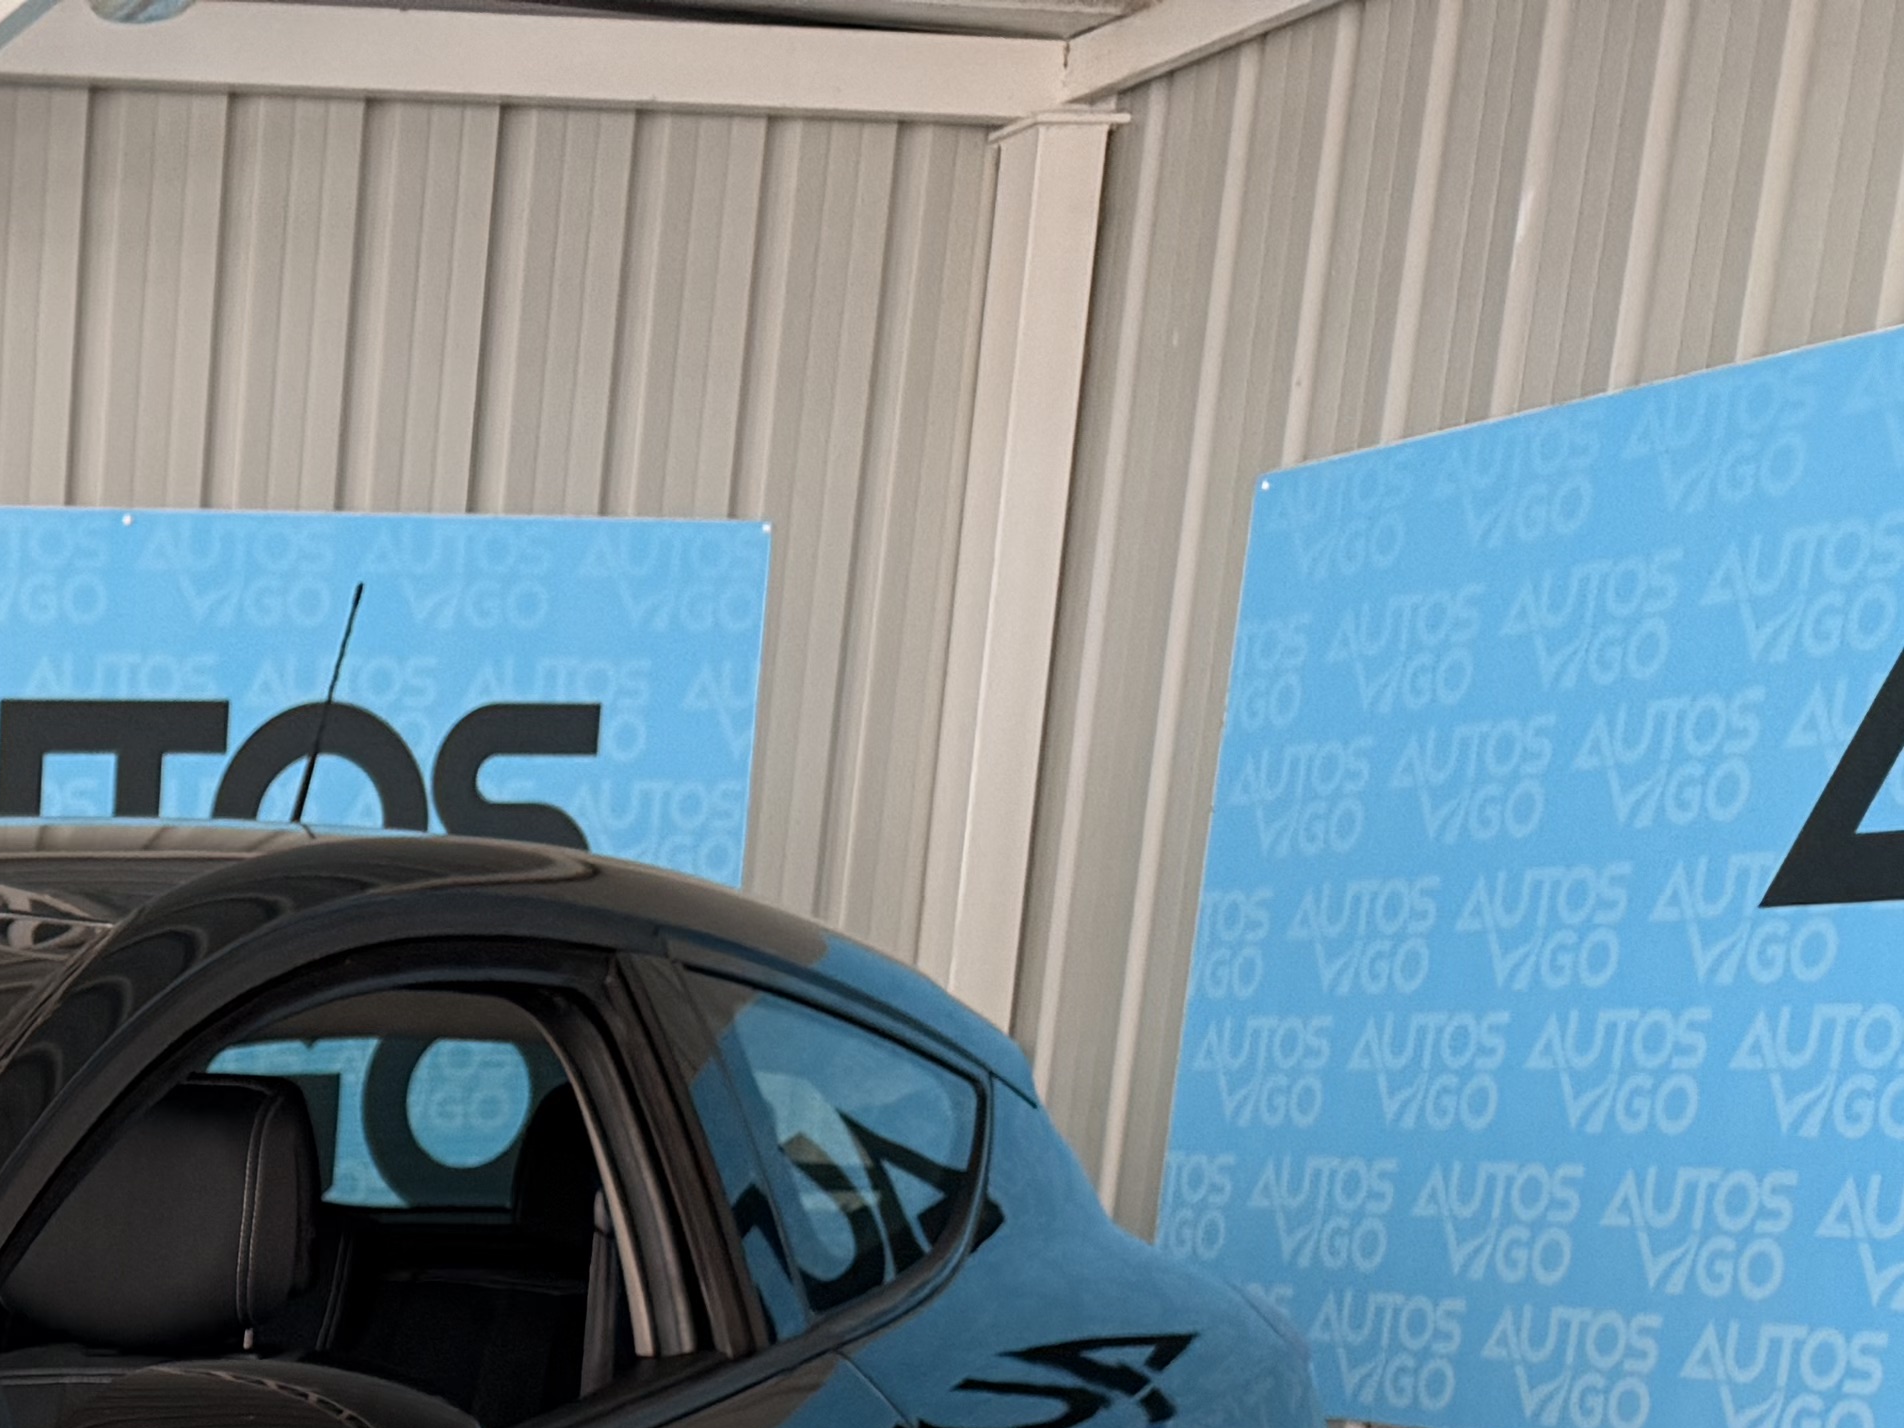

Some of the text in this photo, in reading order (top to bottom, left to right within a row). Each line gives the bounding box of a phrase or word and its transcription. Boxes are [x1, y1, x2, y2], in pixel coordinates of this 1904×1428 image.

[1390, 709, 1559, 790] AUTOS
[1571, 683, 1767, 771] AUTOS
[1418, 778, 1544, 846] VIGO
[1604, 756, 1752, 830] VIGO
[1287, 874, 1441, 942] AUTOS
[1454, 862, 1636, 933] AUTOS
[1312, 937, 1431, 997] VIGO
[1488, 926, 1621, 993] VIGO
[1686, 916, 1839, 987] VIGO
[1195, 1001, 1904, 1072] AUTOS AUTOS AUTOS AUTO
[1215, 1069, 1324, 1130] VIGO
[1375, 1069, 1501, 1132] VIGO
[1556, 1069, 1701, 1135] VIGO
[1247, 1153, 1401, 1211] AUTOS
[1411, 1158, 1585, 1222] AUTOS
[1599, 1164, 1800, 1235] AUTOS
[1273, 1208, 1388, 1274] VIGO
[1440, 1215, 1573, 1287] VIGO
[1635, 1225, 1786, 1300] VIGO
[1307, 1288, 1468, 1352] AUTOS
[1481, 1303, 1663, 1376] AUTOS
[1679, 1319, 1890, 1398] AUTOS
[1337, 1349, 1456, 1412] VIGO
